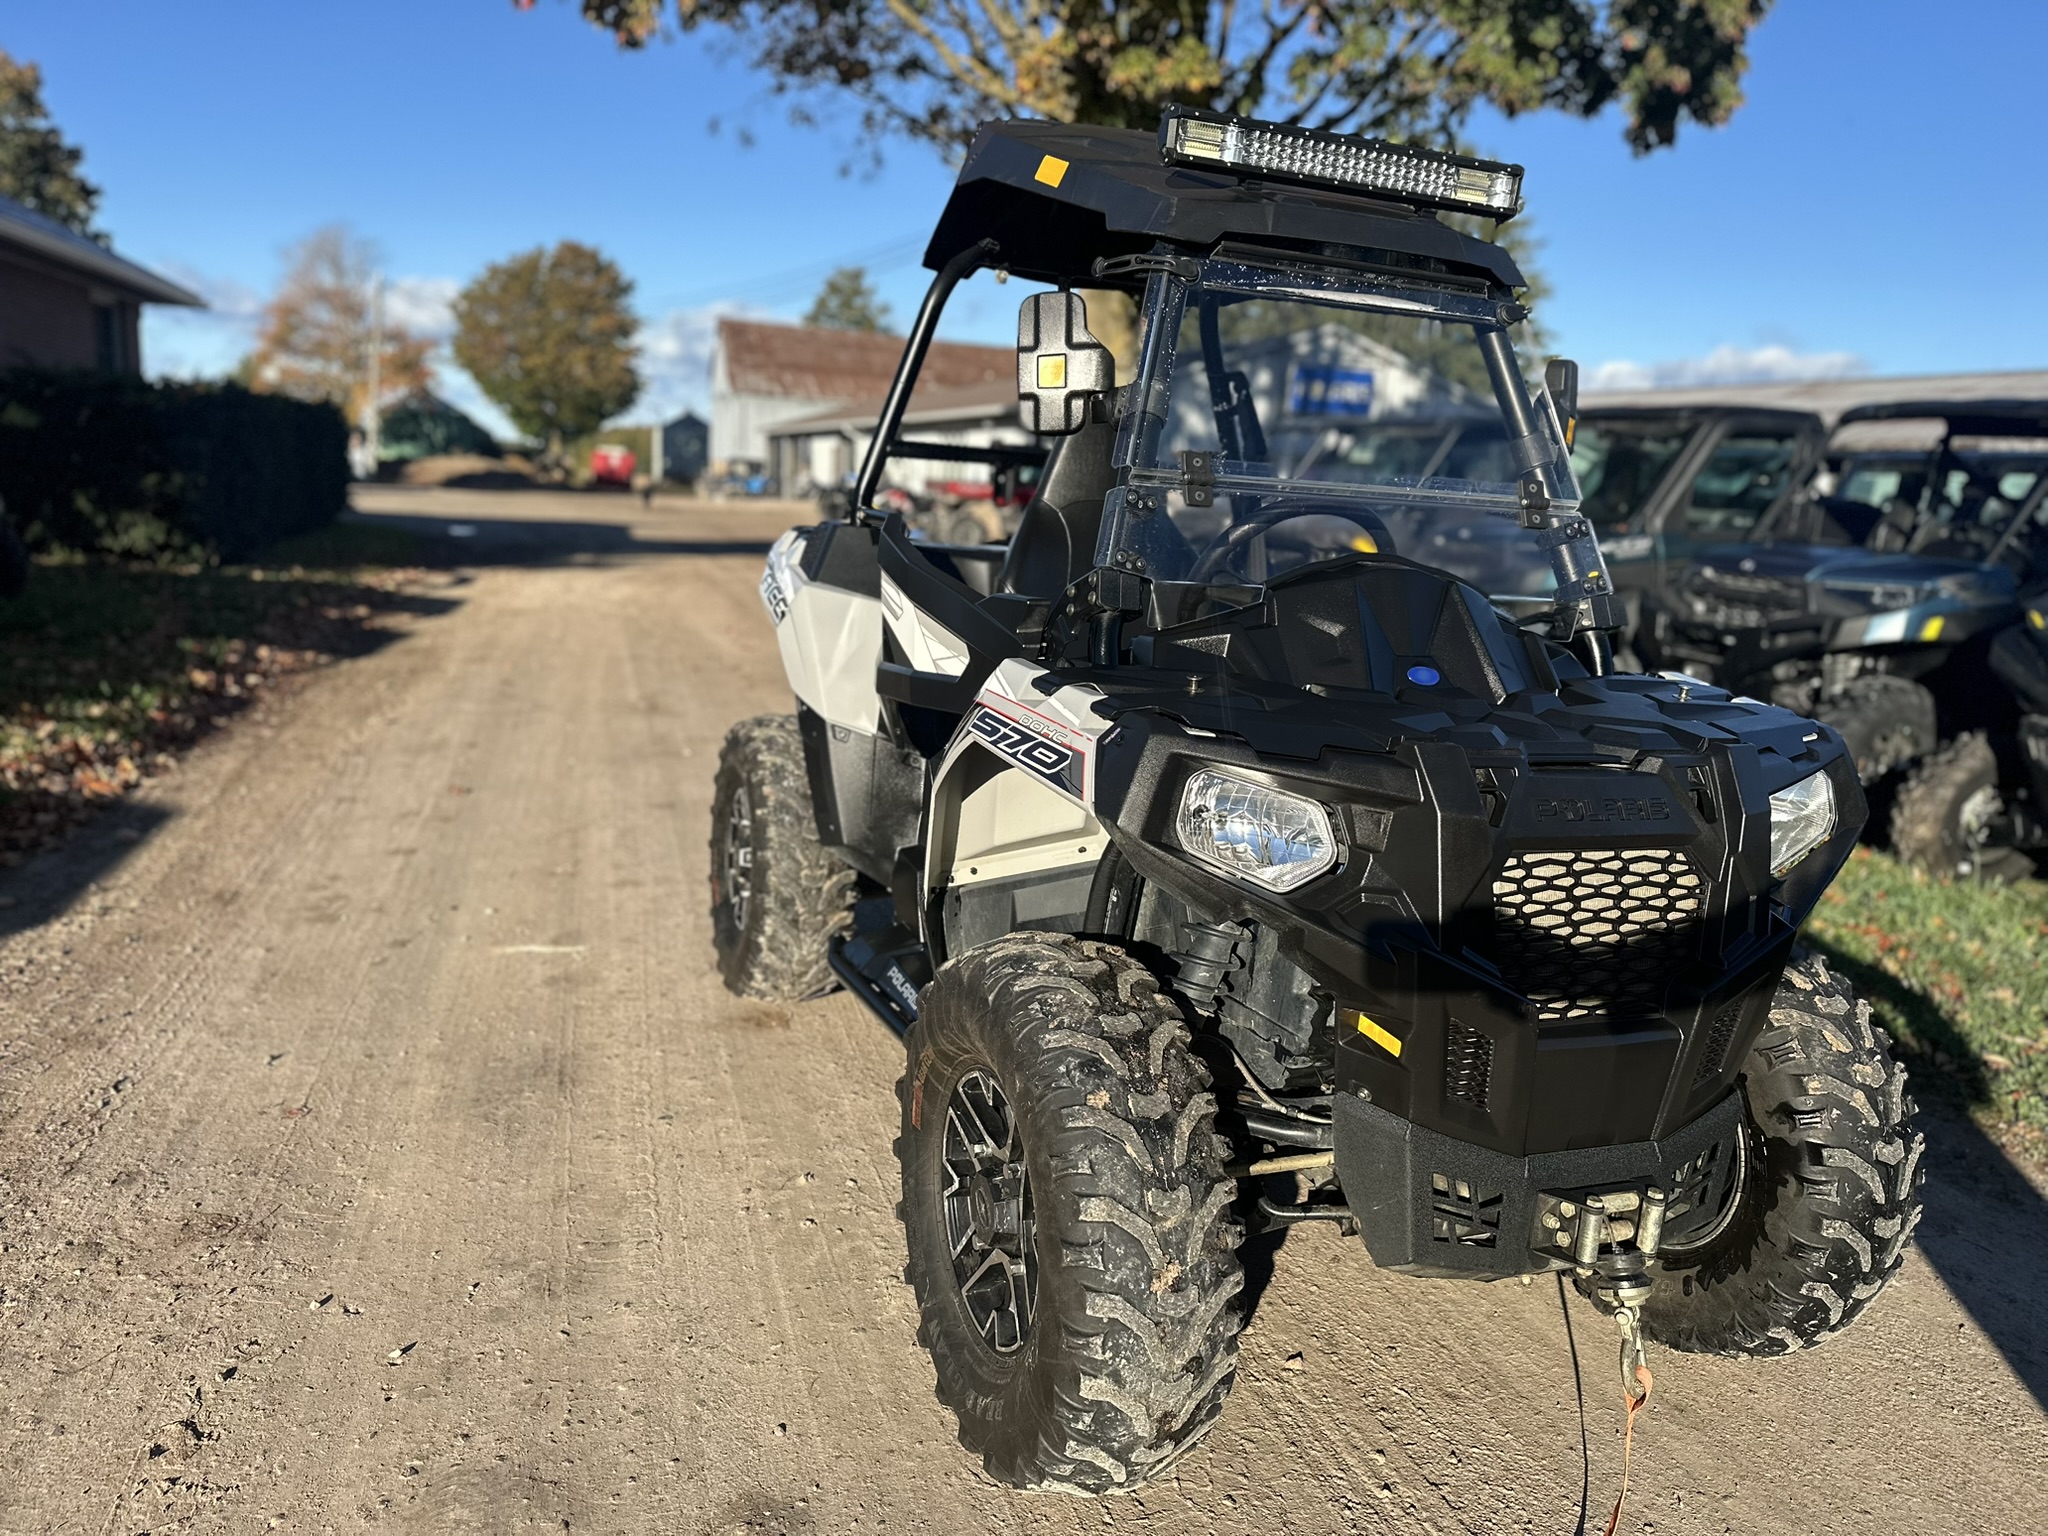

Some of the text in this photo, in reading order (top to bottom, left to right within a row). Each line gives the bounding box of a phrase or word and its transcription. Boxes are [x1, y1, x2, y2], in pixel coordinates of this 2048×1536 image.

[969, 708, 1072, 774] 570
[1018, 714, 1067, 743] DOHC
[1536, 798, 1670, 822] POLARIS
